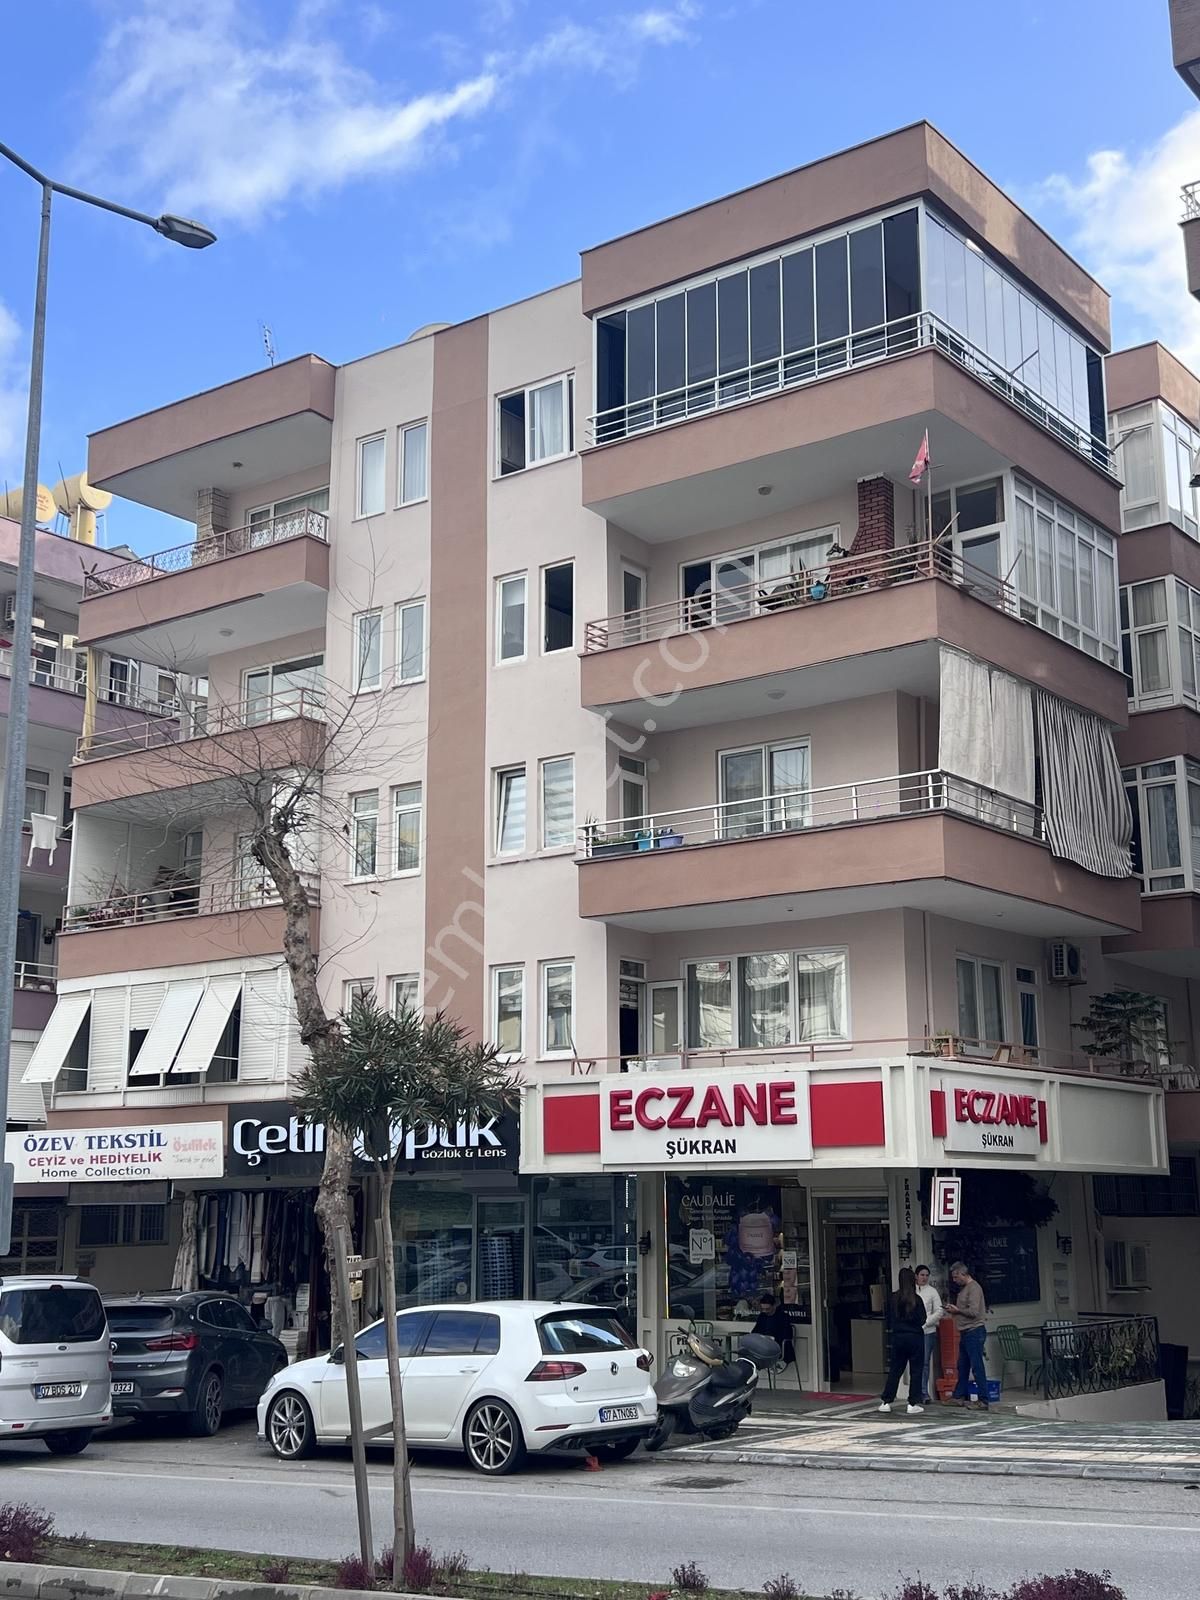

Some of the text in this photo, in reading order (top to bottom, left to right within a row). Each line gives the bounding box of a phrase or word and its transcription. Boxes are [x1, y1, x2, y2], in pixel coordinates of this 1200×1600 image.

[610, 1082, 797, 1131] ECZANE
[954, 1088, 1037, 1127] ECZANE
[23, 1129, 168, 1152] ÖZEV TEKSTİL
[666, 1138, 736, 1159] ŞÜKRAN
[982, 1132, 1014, 1149] ŞÜKRAN
[28, 1154, 66, 1167] CEYİZ
[70, 1157, 84, 1166] ve
[90, 1151, 162, 1165] HEDİYELİK
[465, 1148, 472, 1157] &
[477, 1147, 507, 1158] Lens
[41, 1165, 151, 1178] Home Collection
[943, 1188, 954, 1215] E
[42, 1386, 51, 1397] 07
[113, 1382, 132, 1393] 0323
